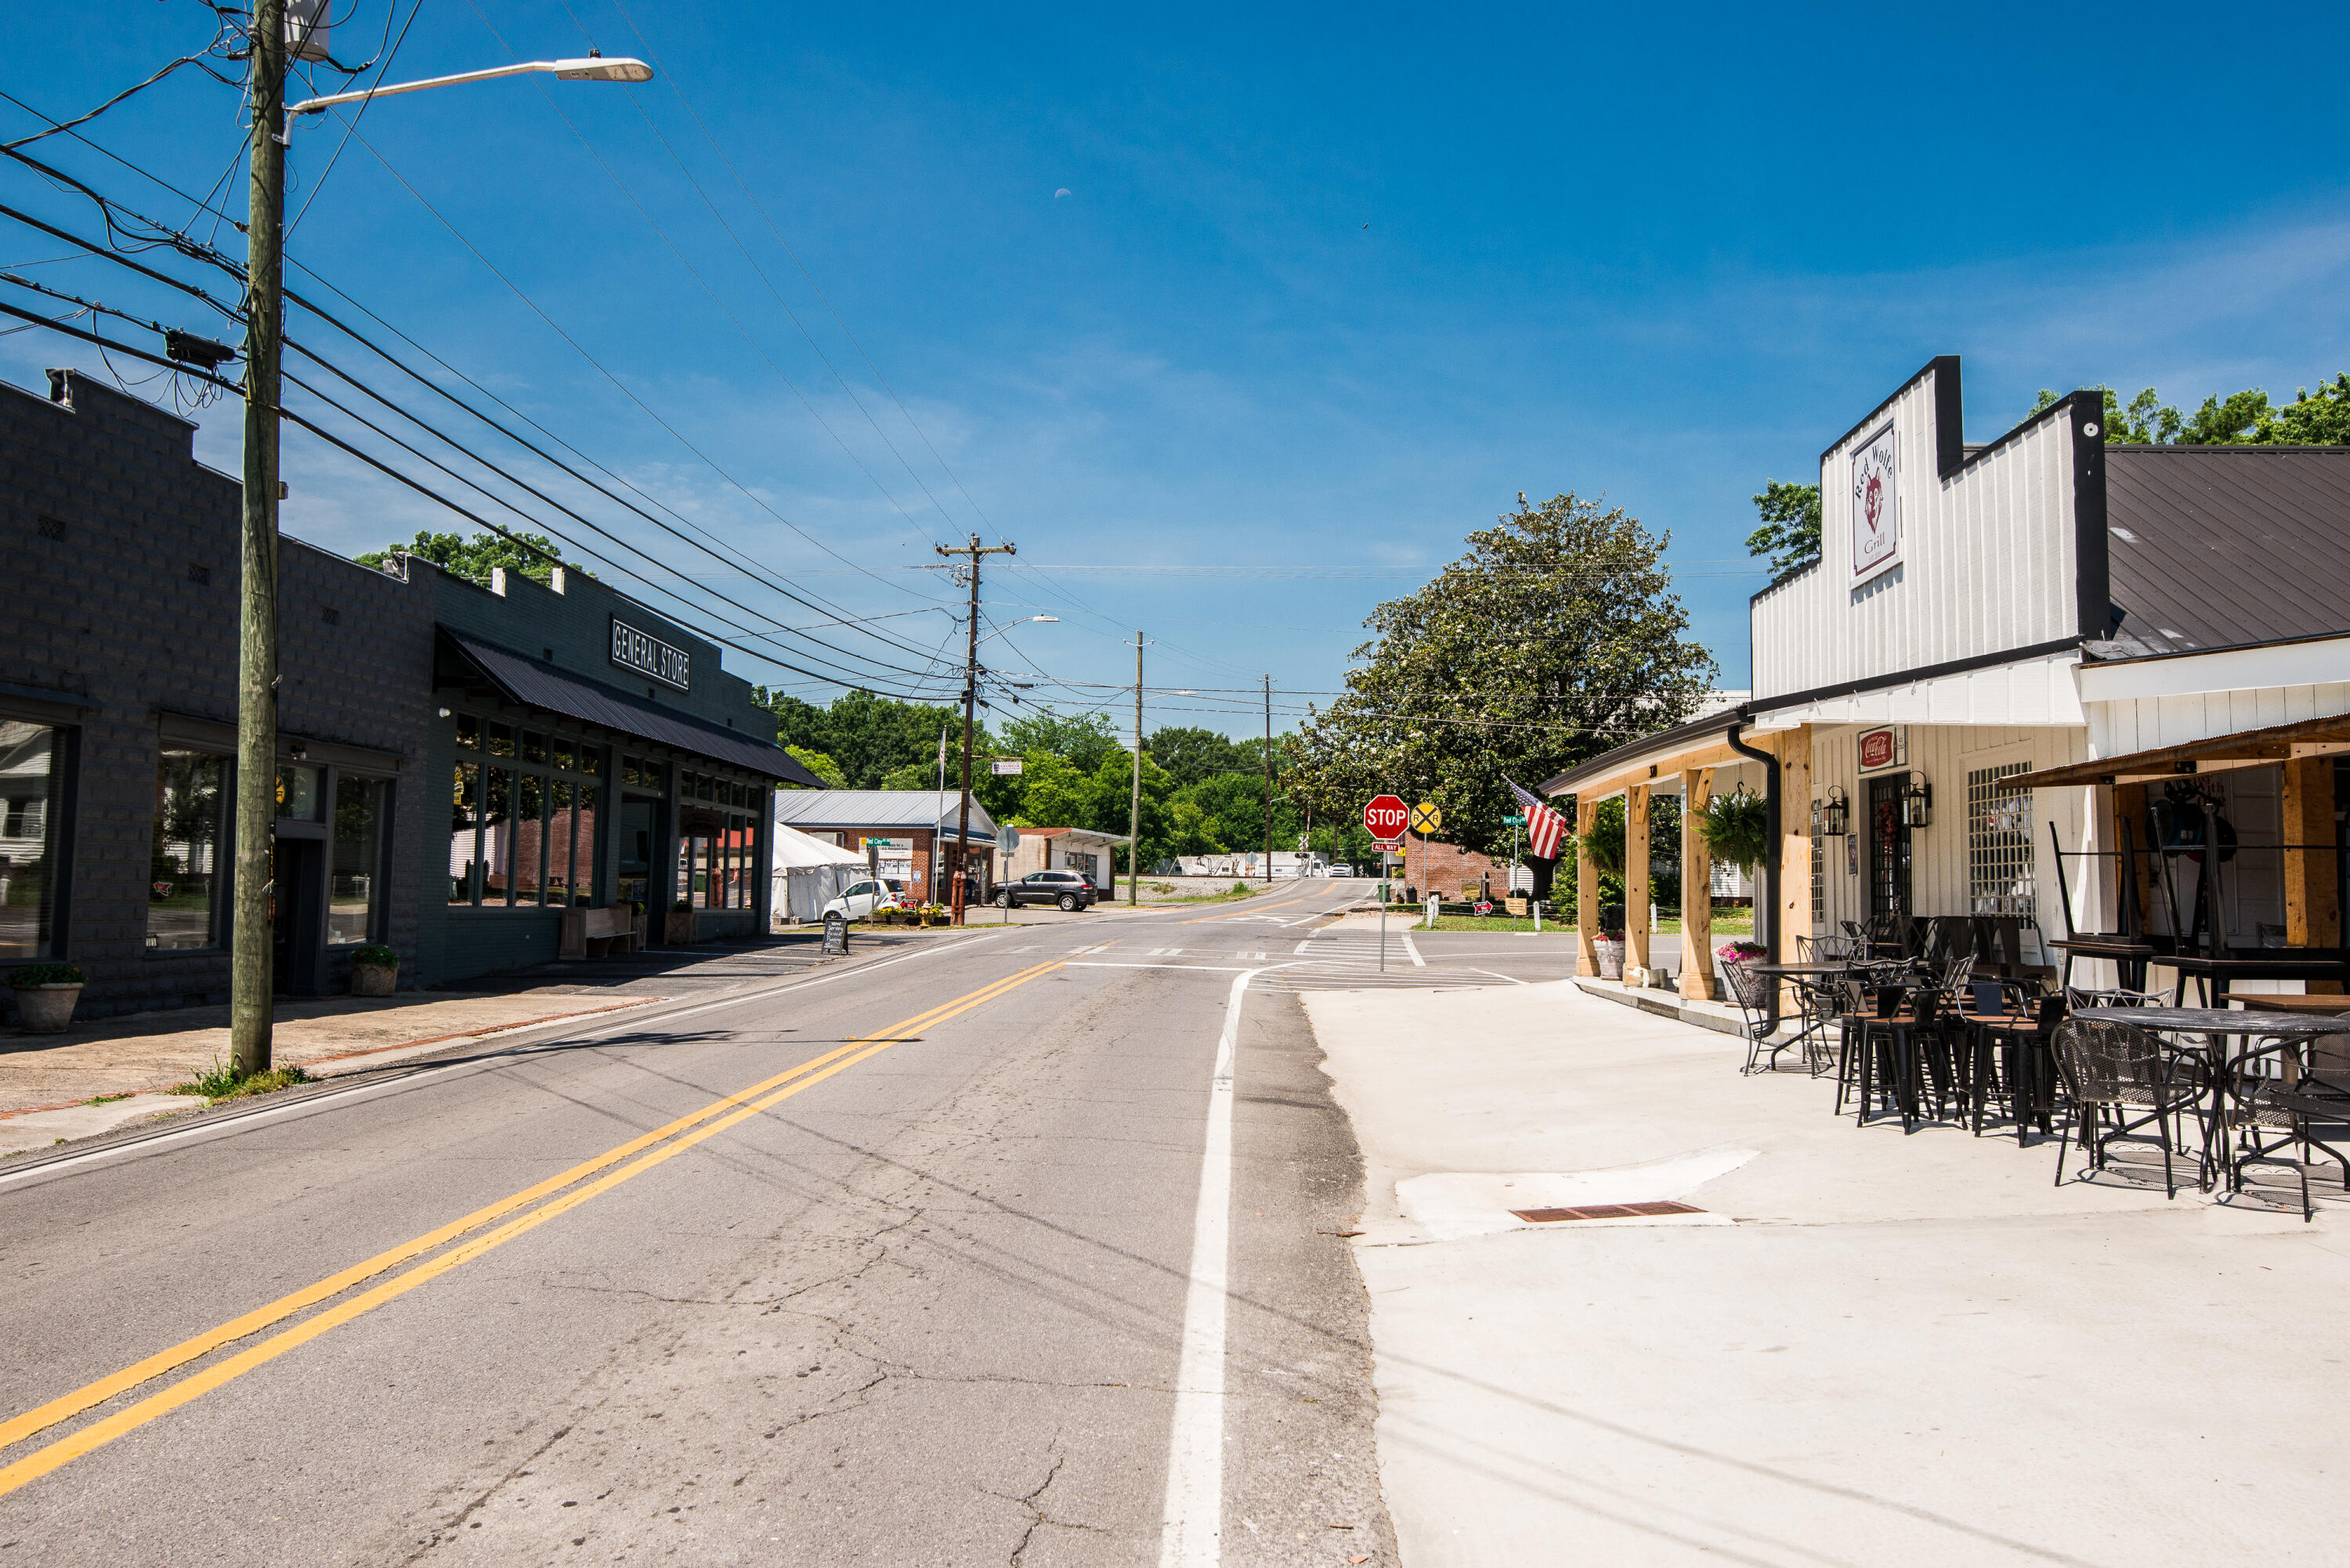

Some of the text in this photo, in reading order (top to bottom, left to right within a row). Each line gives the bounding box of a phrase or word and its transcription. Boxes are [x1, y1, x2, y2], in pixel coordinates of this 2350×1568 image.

[1855, 444, 1893, 500] Red Wolfe
[1864, 532, 1885, 555] Grill
[614, 625, 688, 685] GENERAL STORE
[1367, 808, 1406, 826] STOP
